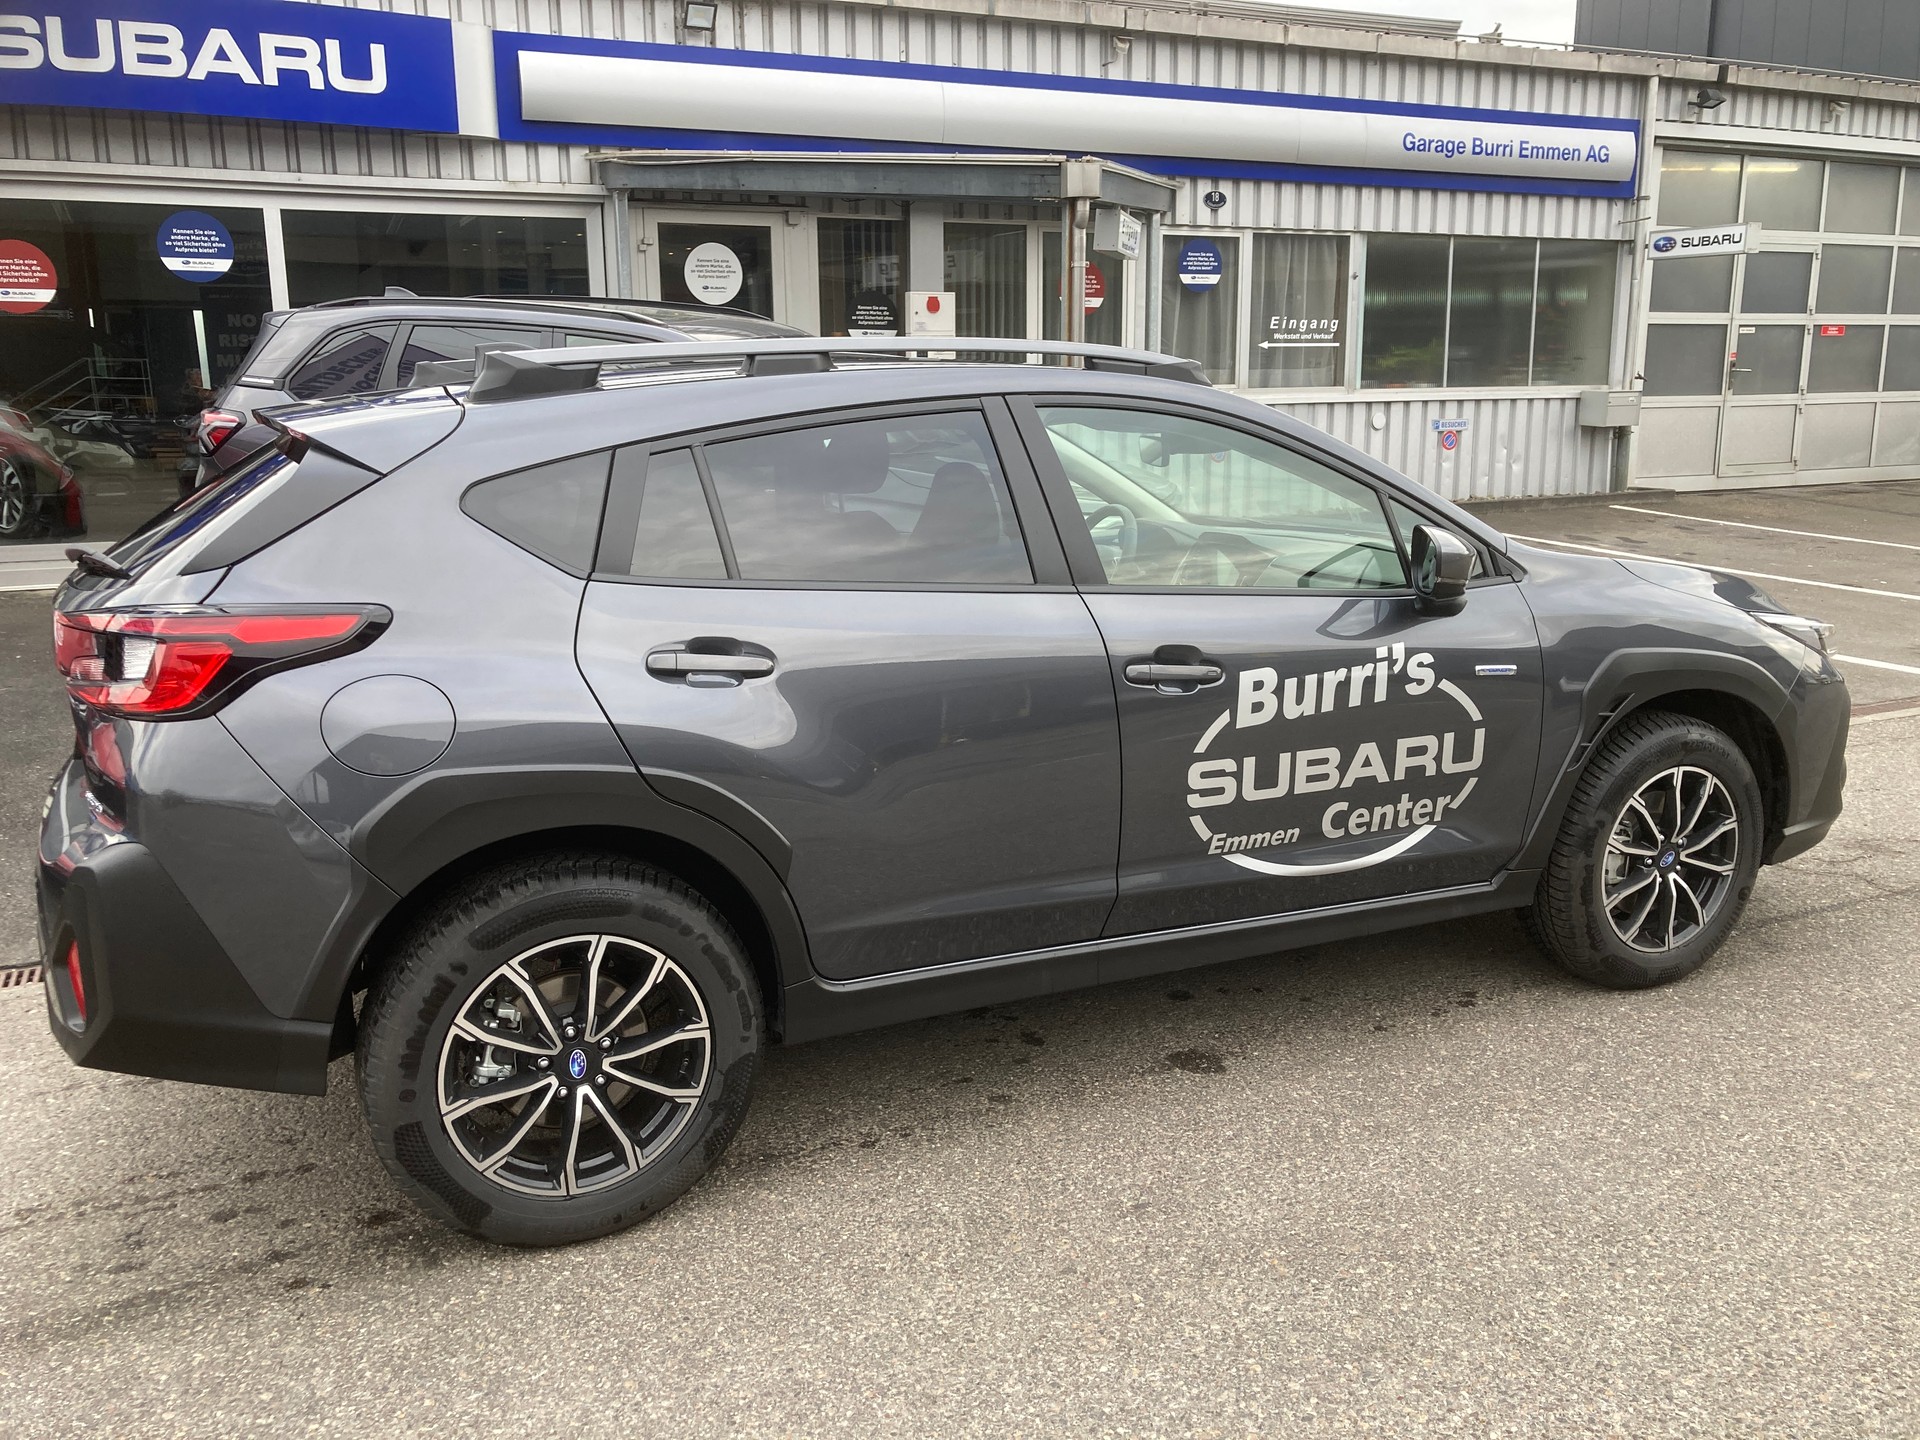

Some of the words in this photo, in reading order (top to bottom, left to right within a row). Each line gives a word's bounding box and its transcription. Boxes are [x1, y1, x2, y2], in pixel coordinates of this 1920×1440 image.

[0, 15, 388, 95] SUBARU
[1402, 132, 1467, 158] Garage
[1471, 137, 1513, 158] Burri
[1518, 140, 1581, 162] Emmen
[1585, 144, 1610, 163] AG
[1211, 192, 1220, 202] 18
[1681, 233, 1743, 248] SUBARU
[1269, 316, 1339, 332] Eingang
[1273, 332, 1300, 340] Werkstatt
[1312, 332, 1335, 340] Verkauf
[1236, 641, 1436, 729] Burri's
[1187, 728, 1486, 809] SUBARU
[1321, 793, 1451, 839] Center
[1208, 827, 1300, 855] Emmen
